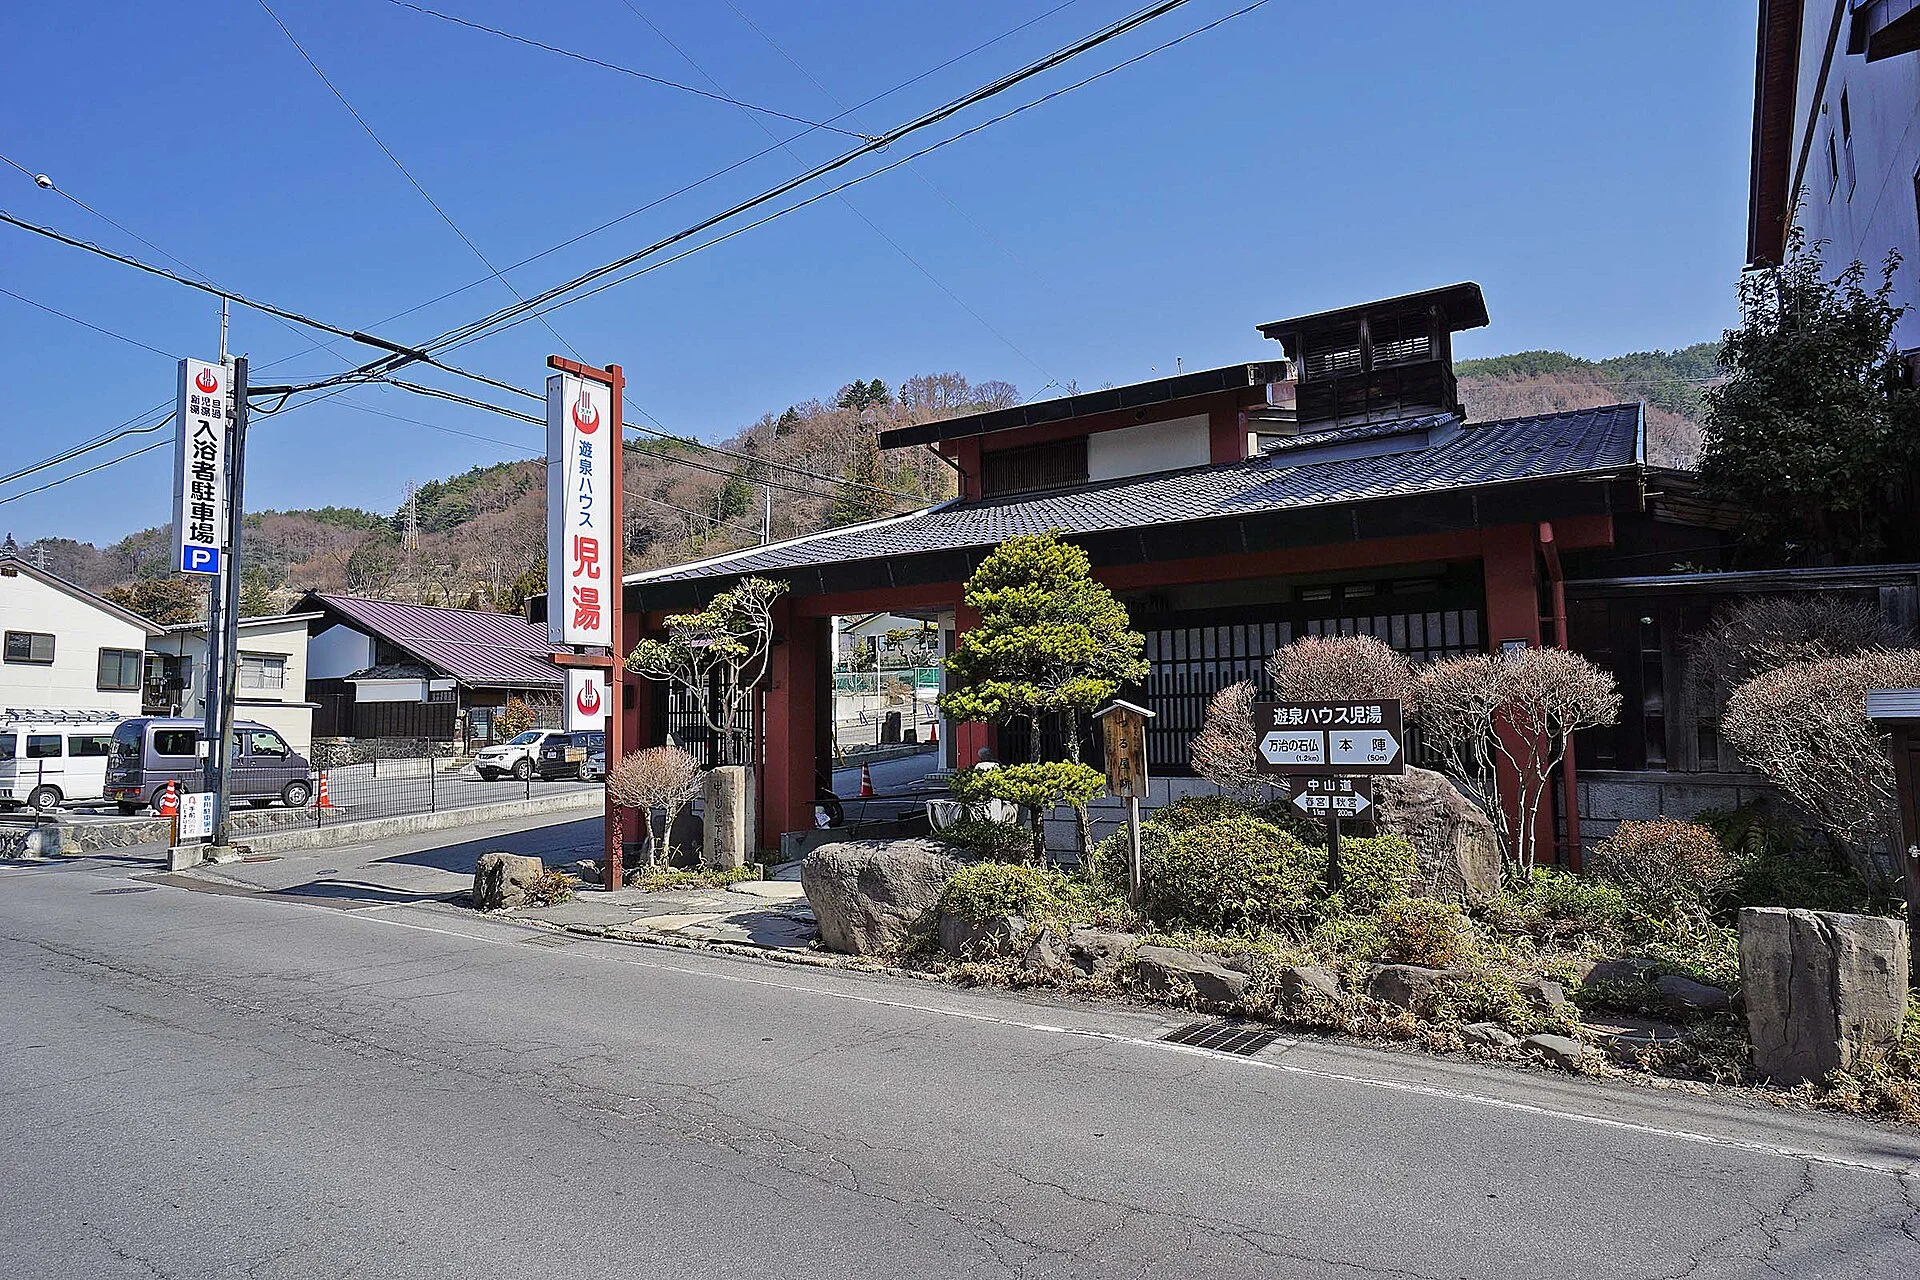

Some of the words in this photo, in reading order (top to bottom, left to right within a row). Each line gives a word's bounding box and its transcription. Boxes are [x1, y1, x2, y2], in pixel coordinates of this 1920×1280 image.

[189, 419, 218, 545] 入浴者駐車場
[578, 440, 593, 527] 遊泉ハウス
[191, 549, 211, 568] P
[572, 535, 600, 631] 児湯
[1273, 705, 1382, 726] 遊泉ハウス児湯
[1268, 738, 1319, 753] 万治の石仏
[1296, 754, 1320, 763] (1.2km)
[1367, 754, 1388, 762] (50m)
[1307, 779, 1353, 792] 中山道
[1305, 798, 1326, 807] 春宮
[1335, 798, 1358, 807] 秋宮
[1337, 809, 1354, 817] 200m
